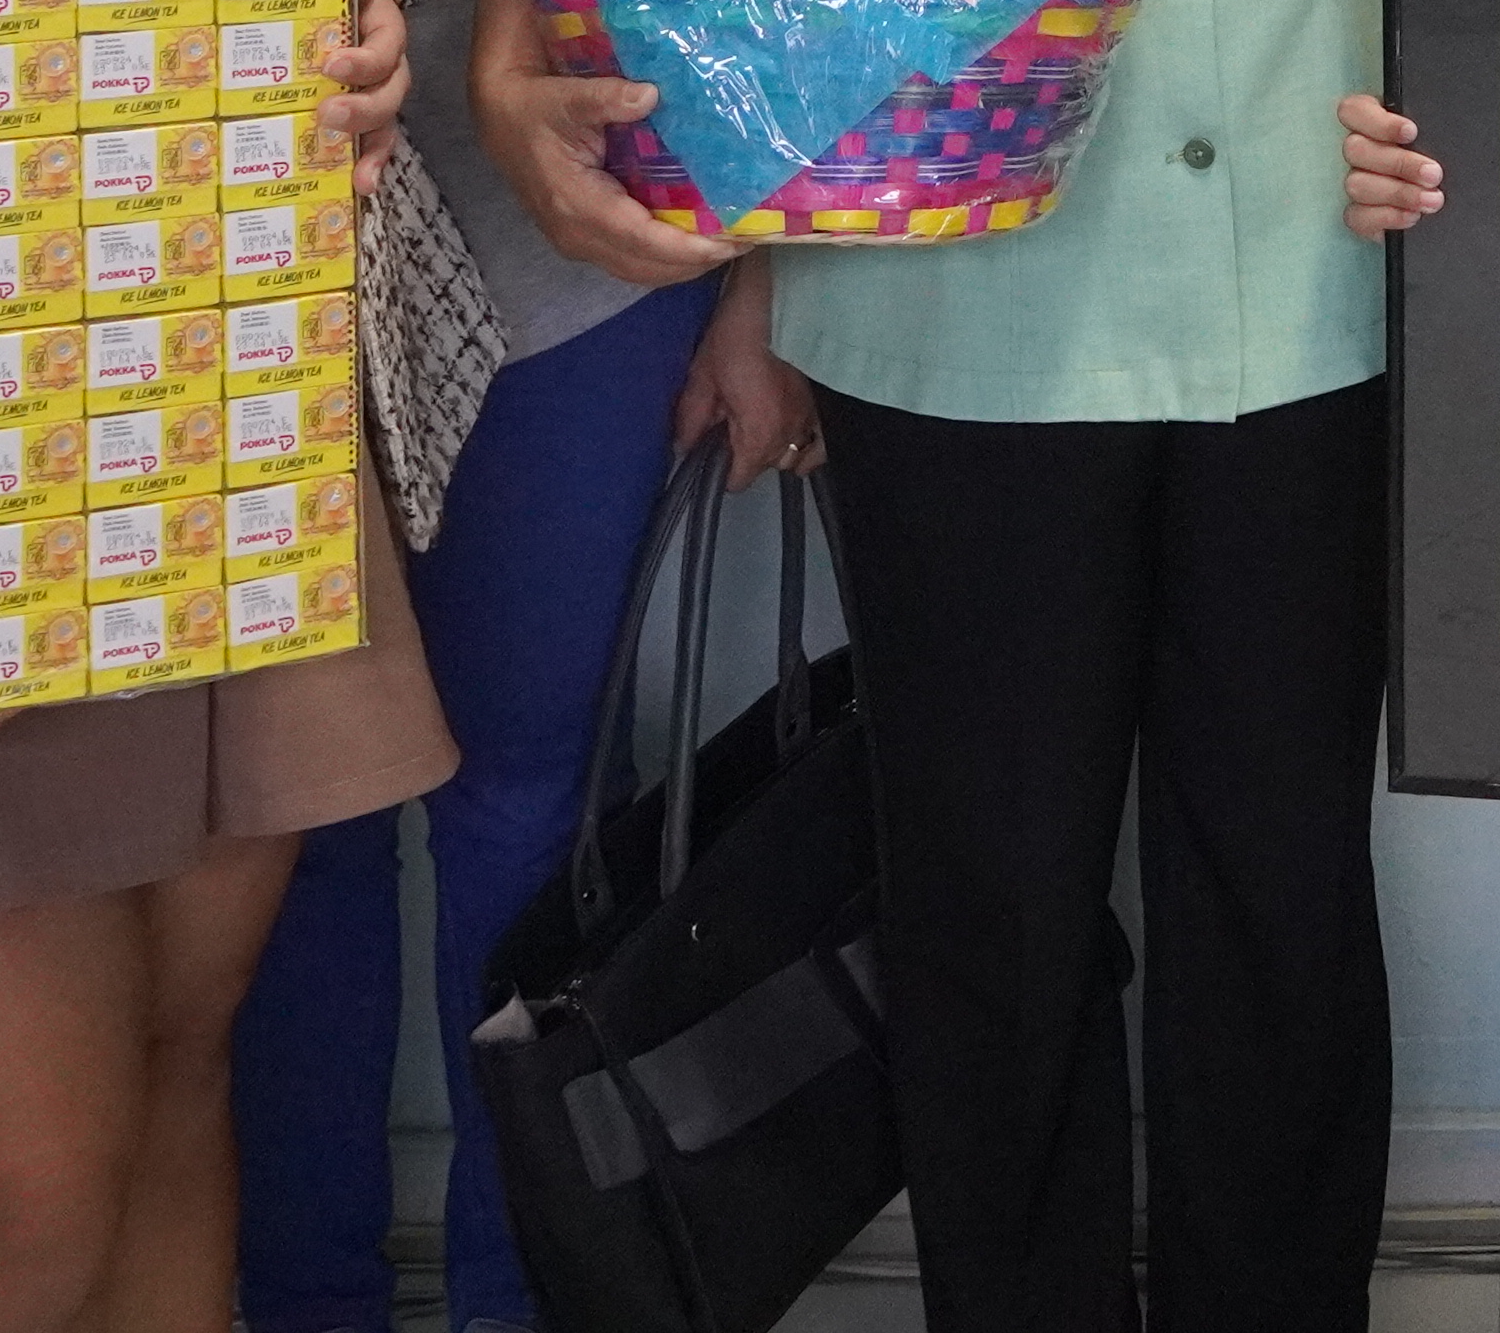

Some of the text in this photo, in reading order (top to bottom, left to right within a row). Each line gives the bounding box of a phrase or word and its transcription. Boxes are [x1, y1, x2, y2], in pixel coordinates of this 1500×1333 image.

[111, 6, 179, 20] ICE LEMON TEA
[250, 1, 266, 12] ICE
[267, 0, 299, 12] LEMON
[22, 19, 40, 30] TEA
[232, 66, 269, 78] POKKA
[252, 87, 318, 102] ICE LEMON TEA
[233, 163, 270, 176] POKKA
[254, 180, 319, 198] ICE LEMON TEA
[98, 267, 136, 281] POKKA
[120, 285, 186, 303] ICE LEMON TEA
[238, 348, 275, 361] POKKA
[99, 365, 137, 378] POKKA
[257, 365, 322, 383] ICE LEMON TEA
[119, 384, 185, 401] ICE LEMON TEA
[240, 619, 277, 635] POKKA
[261, 631, 325, 654] ICE LEMON TEA
